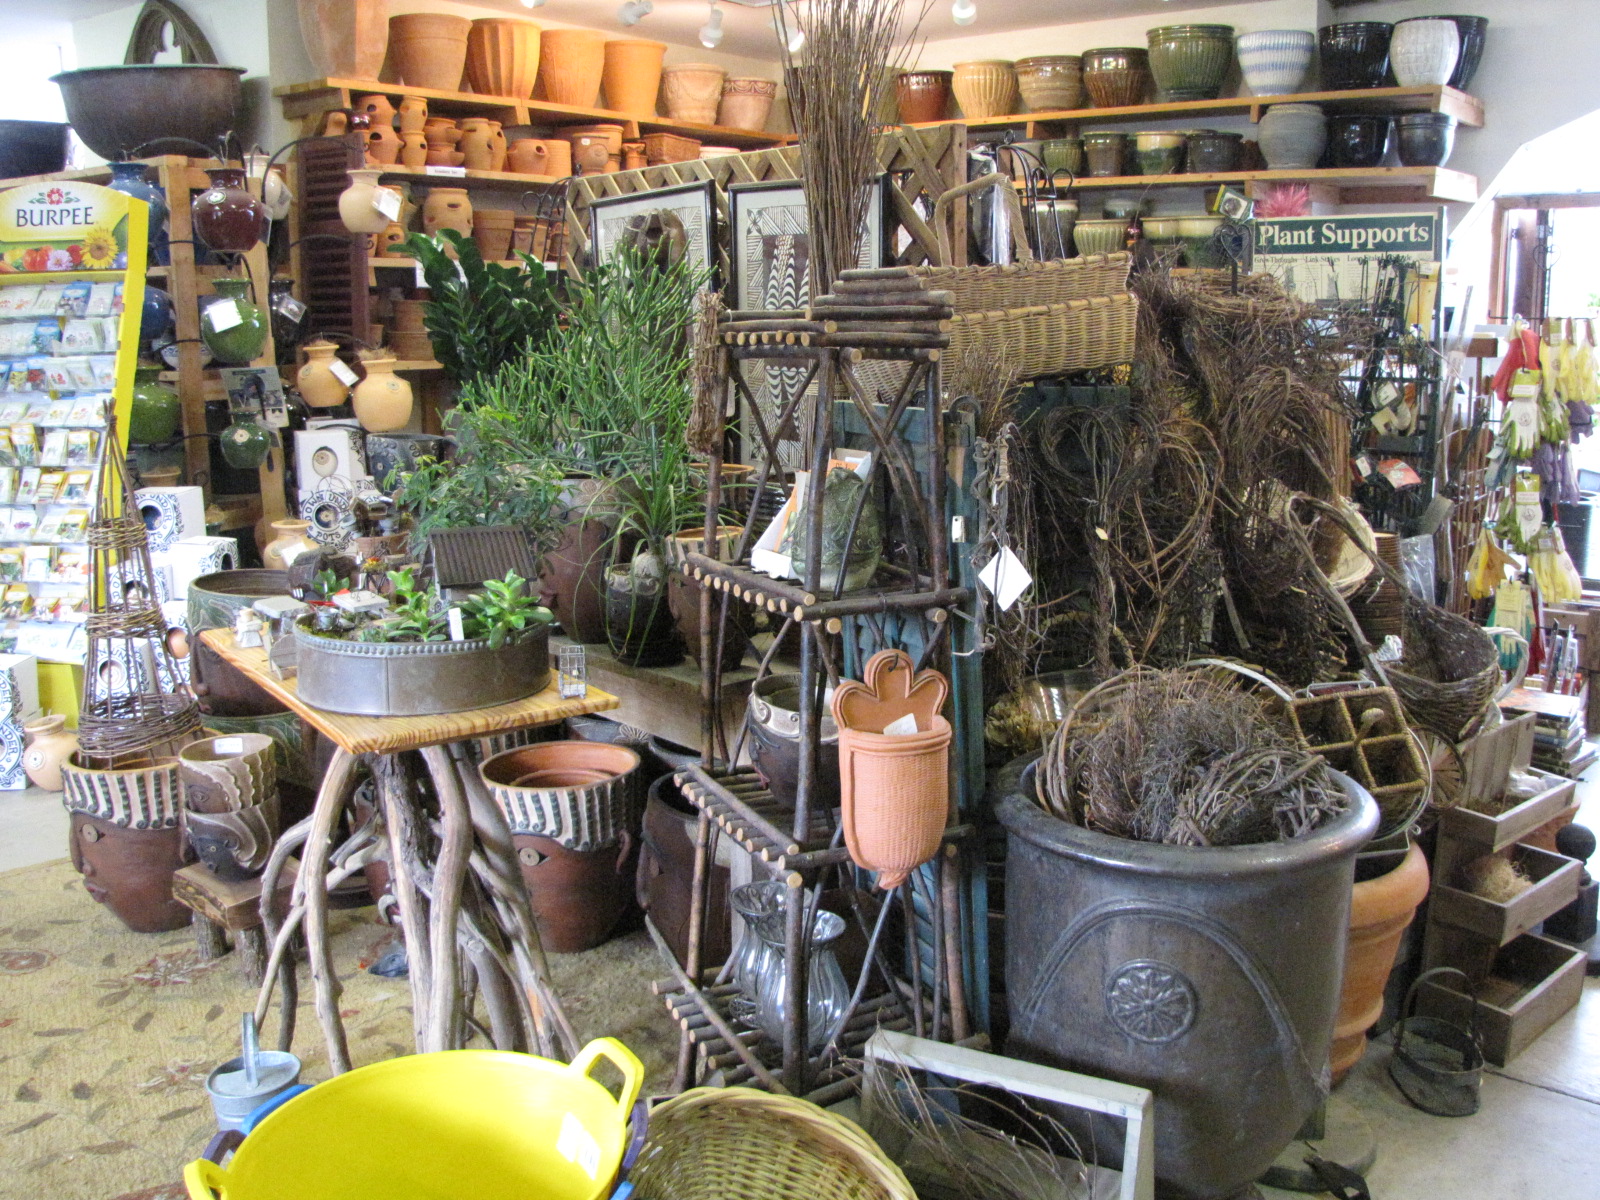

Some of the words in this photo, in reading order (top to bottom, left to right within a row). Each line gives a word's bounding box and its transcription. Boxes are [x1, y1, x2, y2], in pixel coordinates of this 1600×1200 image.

[16, 206, 95, 228] BURPEE
[1258, 224, 1316, 247] Plant
[1321, 221, 1430, 250] Supports
[305, 493, 325, 522] DOWN
[315, 530, 342, 542] POTS
